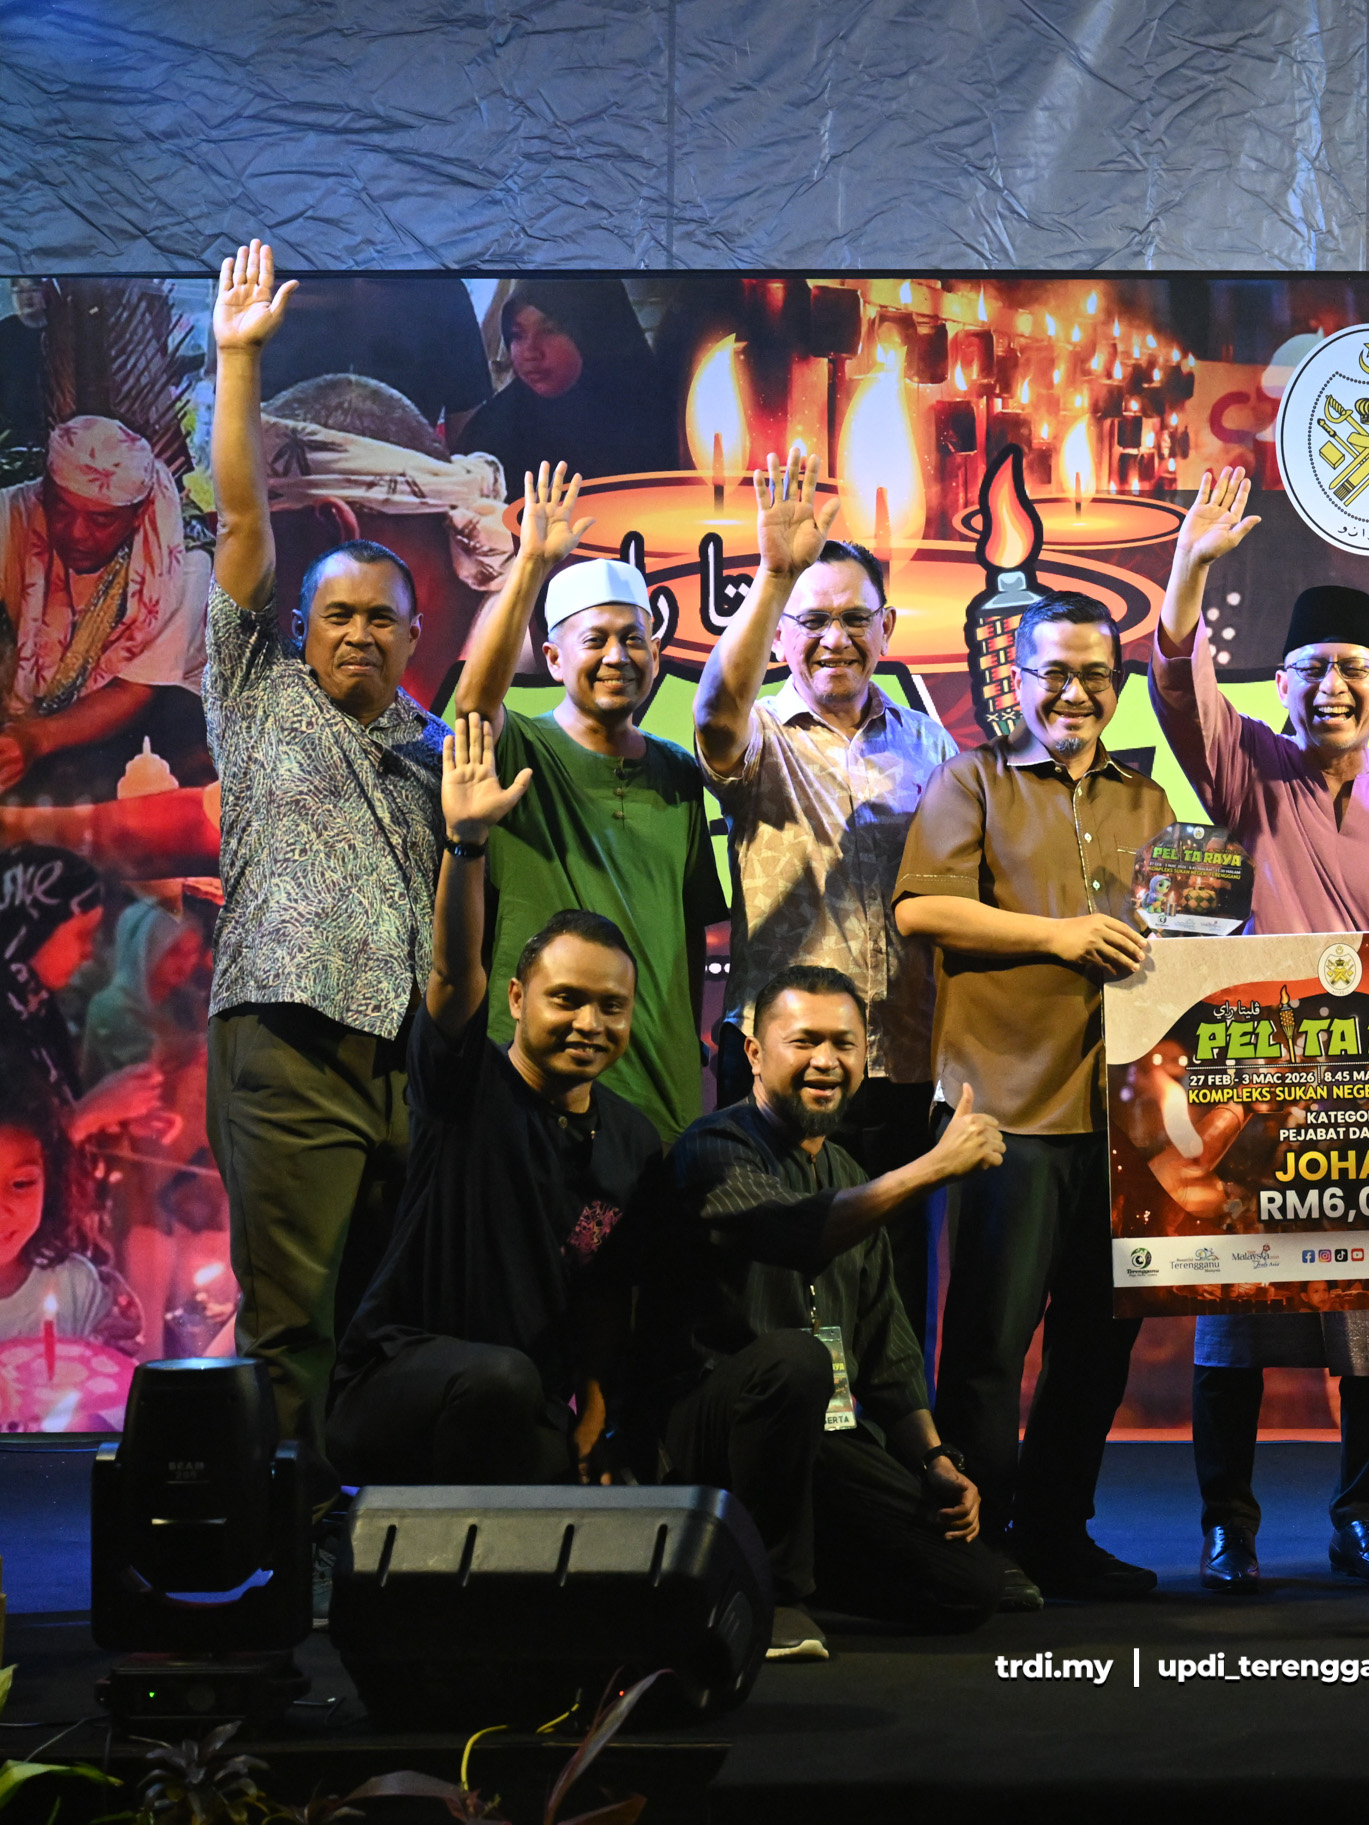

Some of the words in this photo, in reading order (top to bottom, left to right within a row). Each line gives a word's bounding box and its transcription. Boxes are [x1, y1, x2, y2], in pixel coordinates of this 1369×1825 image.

[1203, 852, 1242, 867] RAYA
[1189, 1075, 1204, 1086] 27
[1207, 1074, 1231, 1085] FEB
[1242, 1074, 1249, 1084] 3
[1252, 1073, 1282, 1084] MAC
[1285, 1072, 1315, 1083] 2026
[1324, 1070, 1350, 1082] 8.45
[1188, 1087, 1271, 1104] KOMPLEKS
[1276, 1085, 1328, 1101] SUKAN
[1279, 1127, 1346, 1141] PEJABAT
[1171, 1260, 1220, 1271] Terengganu
[826, 1416, 850, 1425] ERTA
